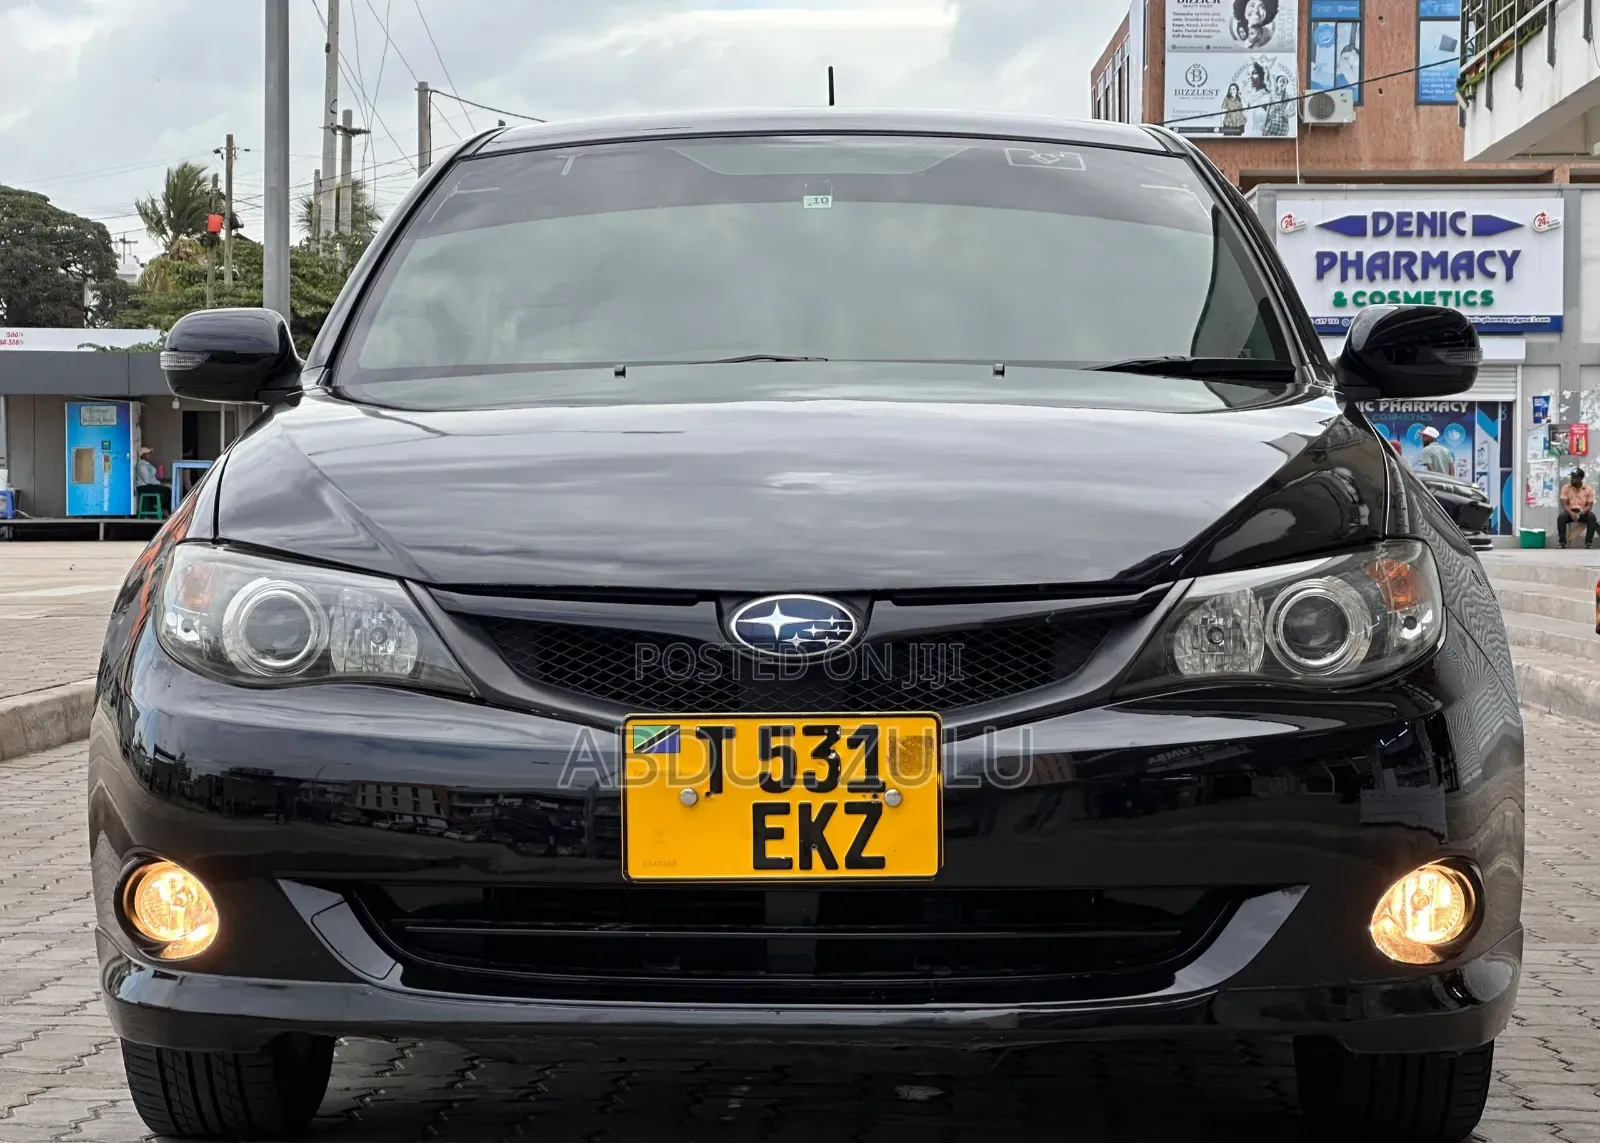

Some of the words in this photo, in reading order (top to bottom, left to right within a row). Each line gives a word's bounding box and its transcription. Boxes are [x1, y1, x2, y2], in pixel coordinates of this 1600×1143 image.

[1372, 211, 1467, 237] DENIC
[1315, 250, 1522, 282] PHARMACY
[1333, 290, 1347, 307] &
[1352, 290, 1494, 307] COSMETICS
[1372, 413, 1433, 421] COSMETICS
[1379, 401, 1469, 413] PHARMACY
[695, 724, 736, 795] T
[758, 724, 886, 794] 531
[752, 801, 886, 871] EKZ
